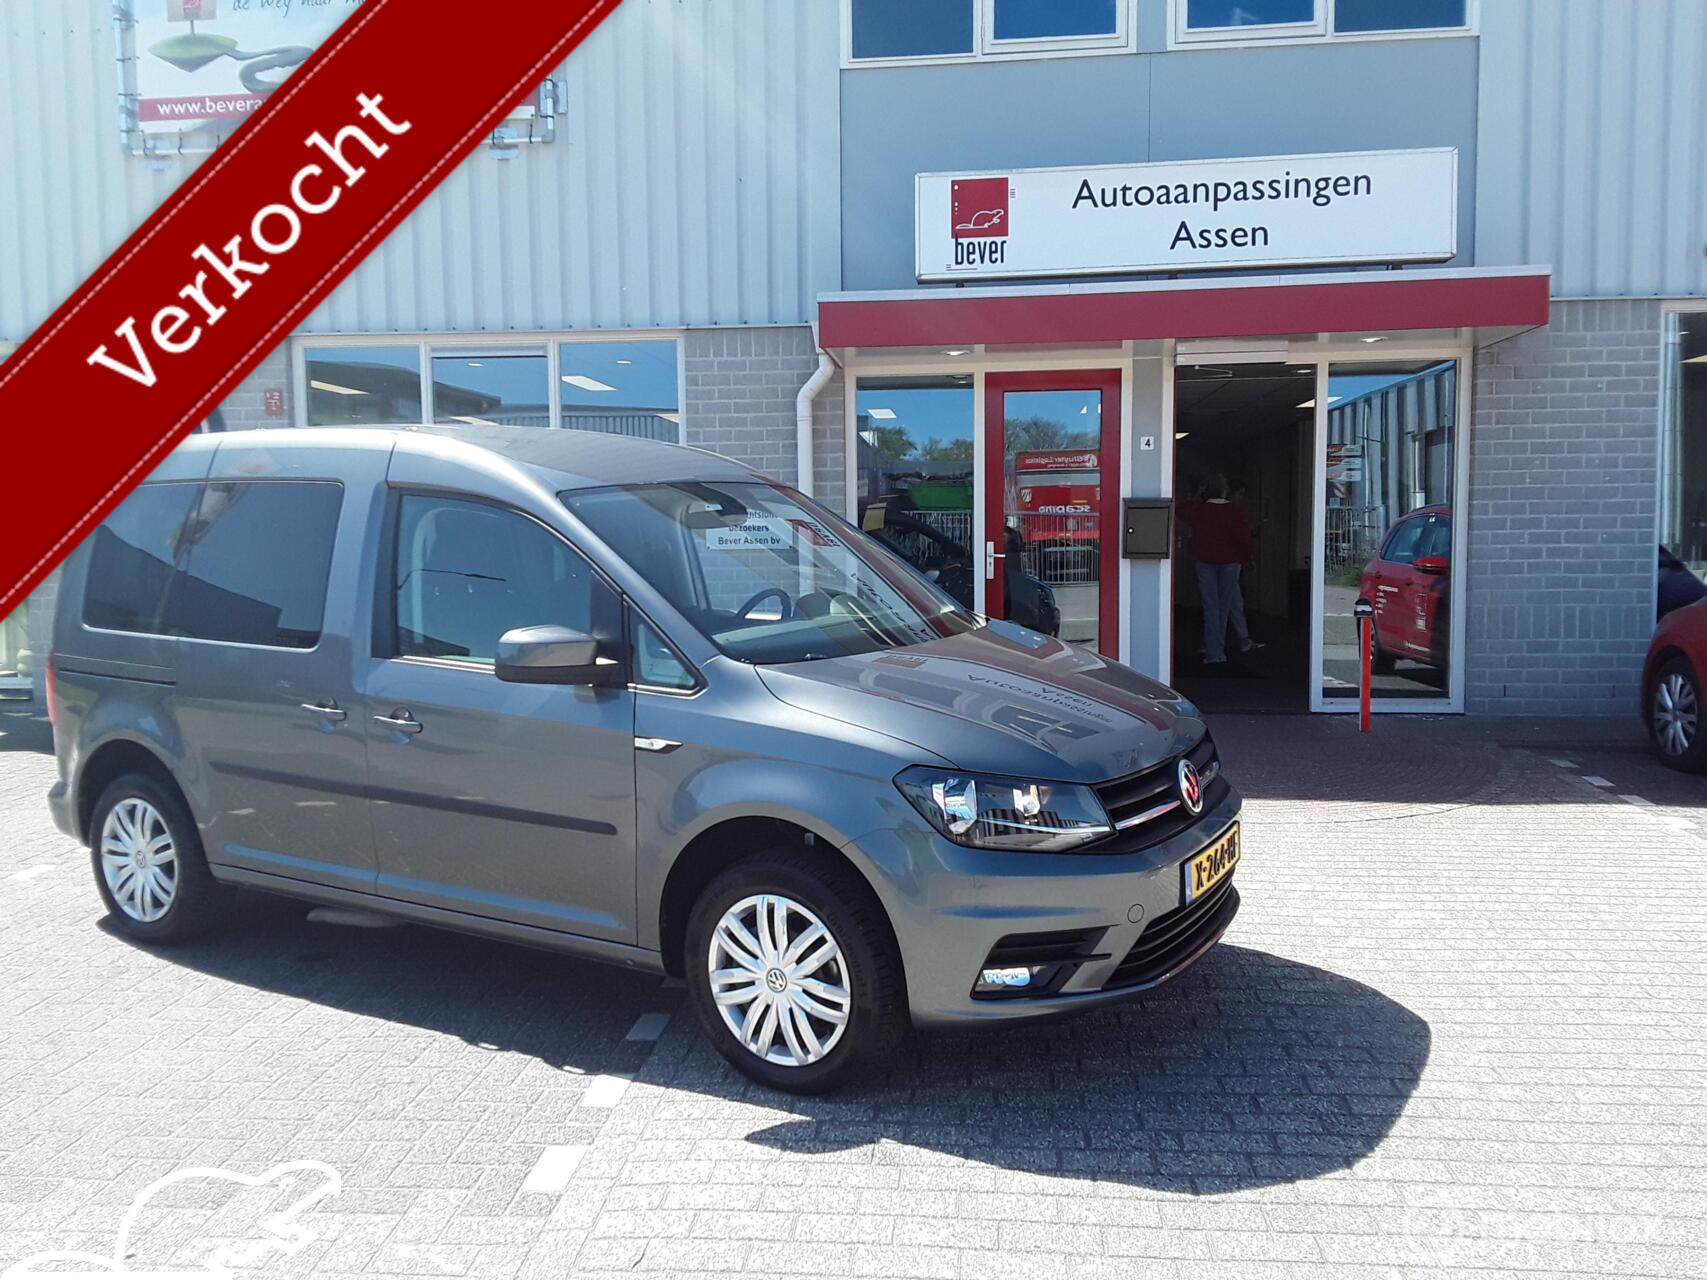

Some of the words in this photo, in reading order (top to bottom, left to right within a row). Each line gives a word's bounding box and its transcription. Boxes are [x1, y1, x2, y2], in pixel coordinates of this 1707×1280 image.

[156, 97, 267, 115] www.bevera
[1072, 170, 1372, 212] Autoaanpassingen
[1169, 220, 1269, 250] Assen
[954, 231, 1008, 266] bever
[1144, 438, 1152, 448] 4
[717, 535, 742, 545] Bever
[743, 535, 769, 545] Assen
